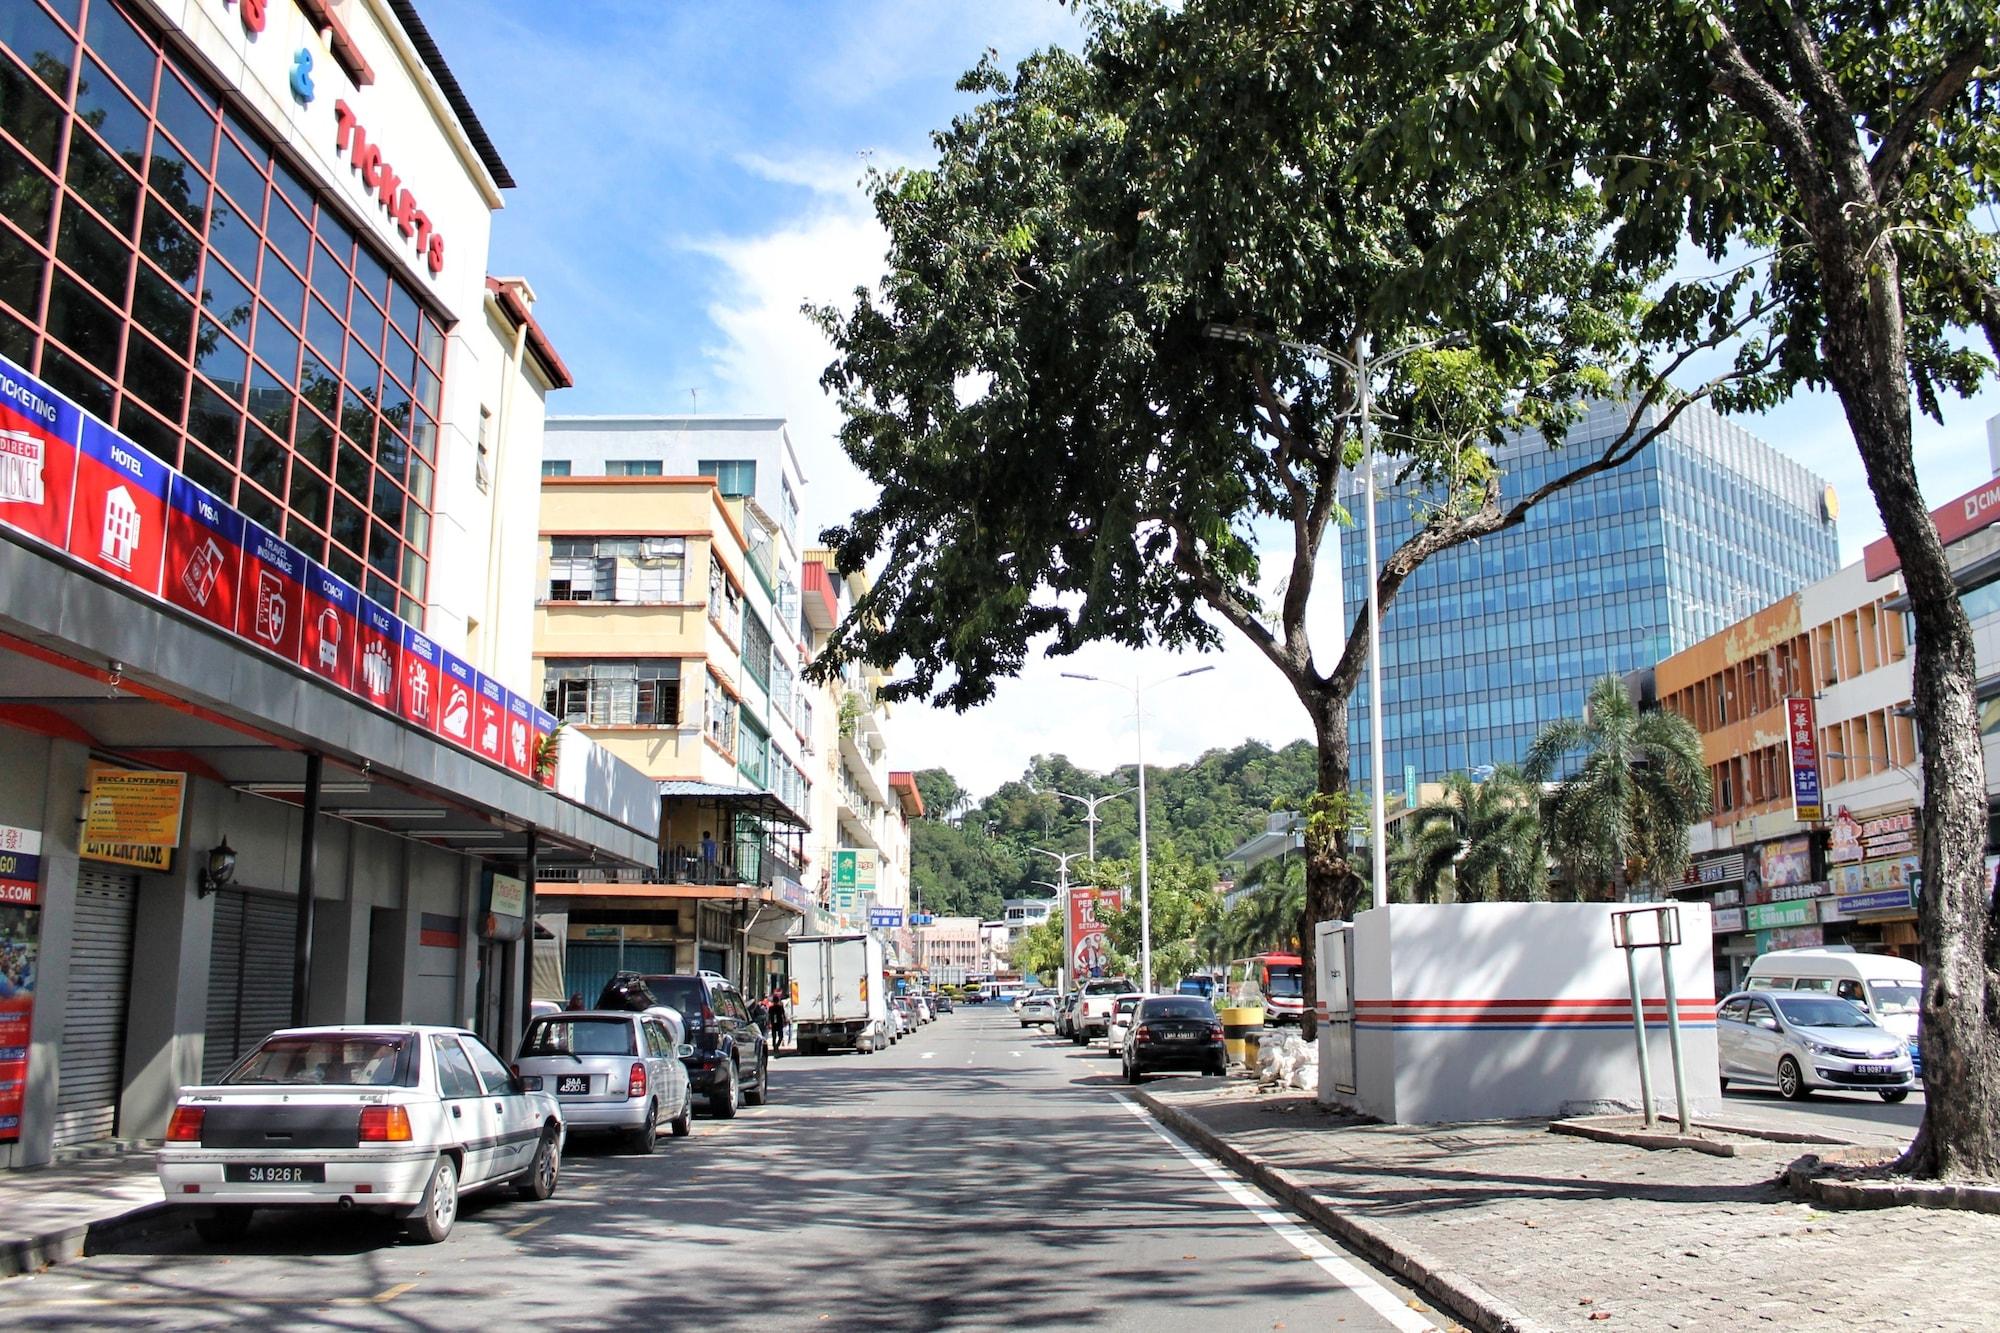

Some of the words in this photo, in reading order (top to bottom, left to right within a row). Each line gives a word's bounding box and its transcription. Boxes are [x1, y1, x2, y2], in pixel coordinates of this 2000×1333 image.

[335, 98, 445, 273] TICKETS
[0, 374, 57, 422] TICKETING
[0, 438, 38, 459] DIRECT
[111, 445, 144, 478] HOTEL
[198, 500, 220, 525] VISA
[257, 544, 293, 575] INSURANCE
[264, 537, 288, 560] TRAVEL
[322, 580, 344, 601] COACH
[0, 856, 17, 873] GO!
[870, 909, 902, 917] PHARMACY
[565, 1077, 582, 1085] SAA
[249, 1168, 264, 1181] SA
[267, 1168, 291, 1181] 926
[294, 1168, 302, 1181] R
